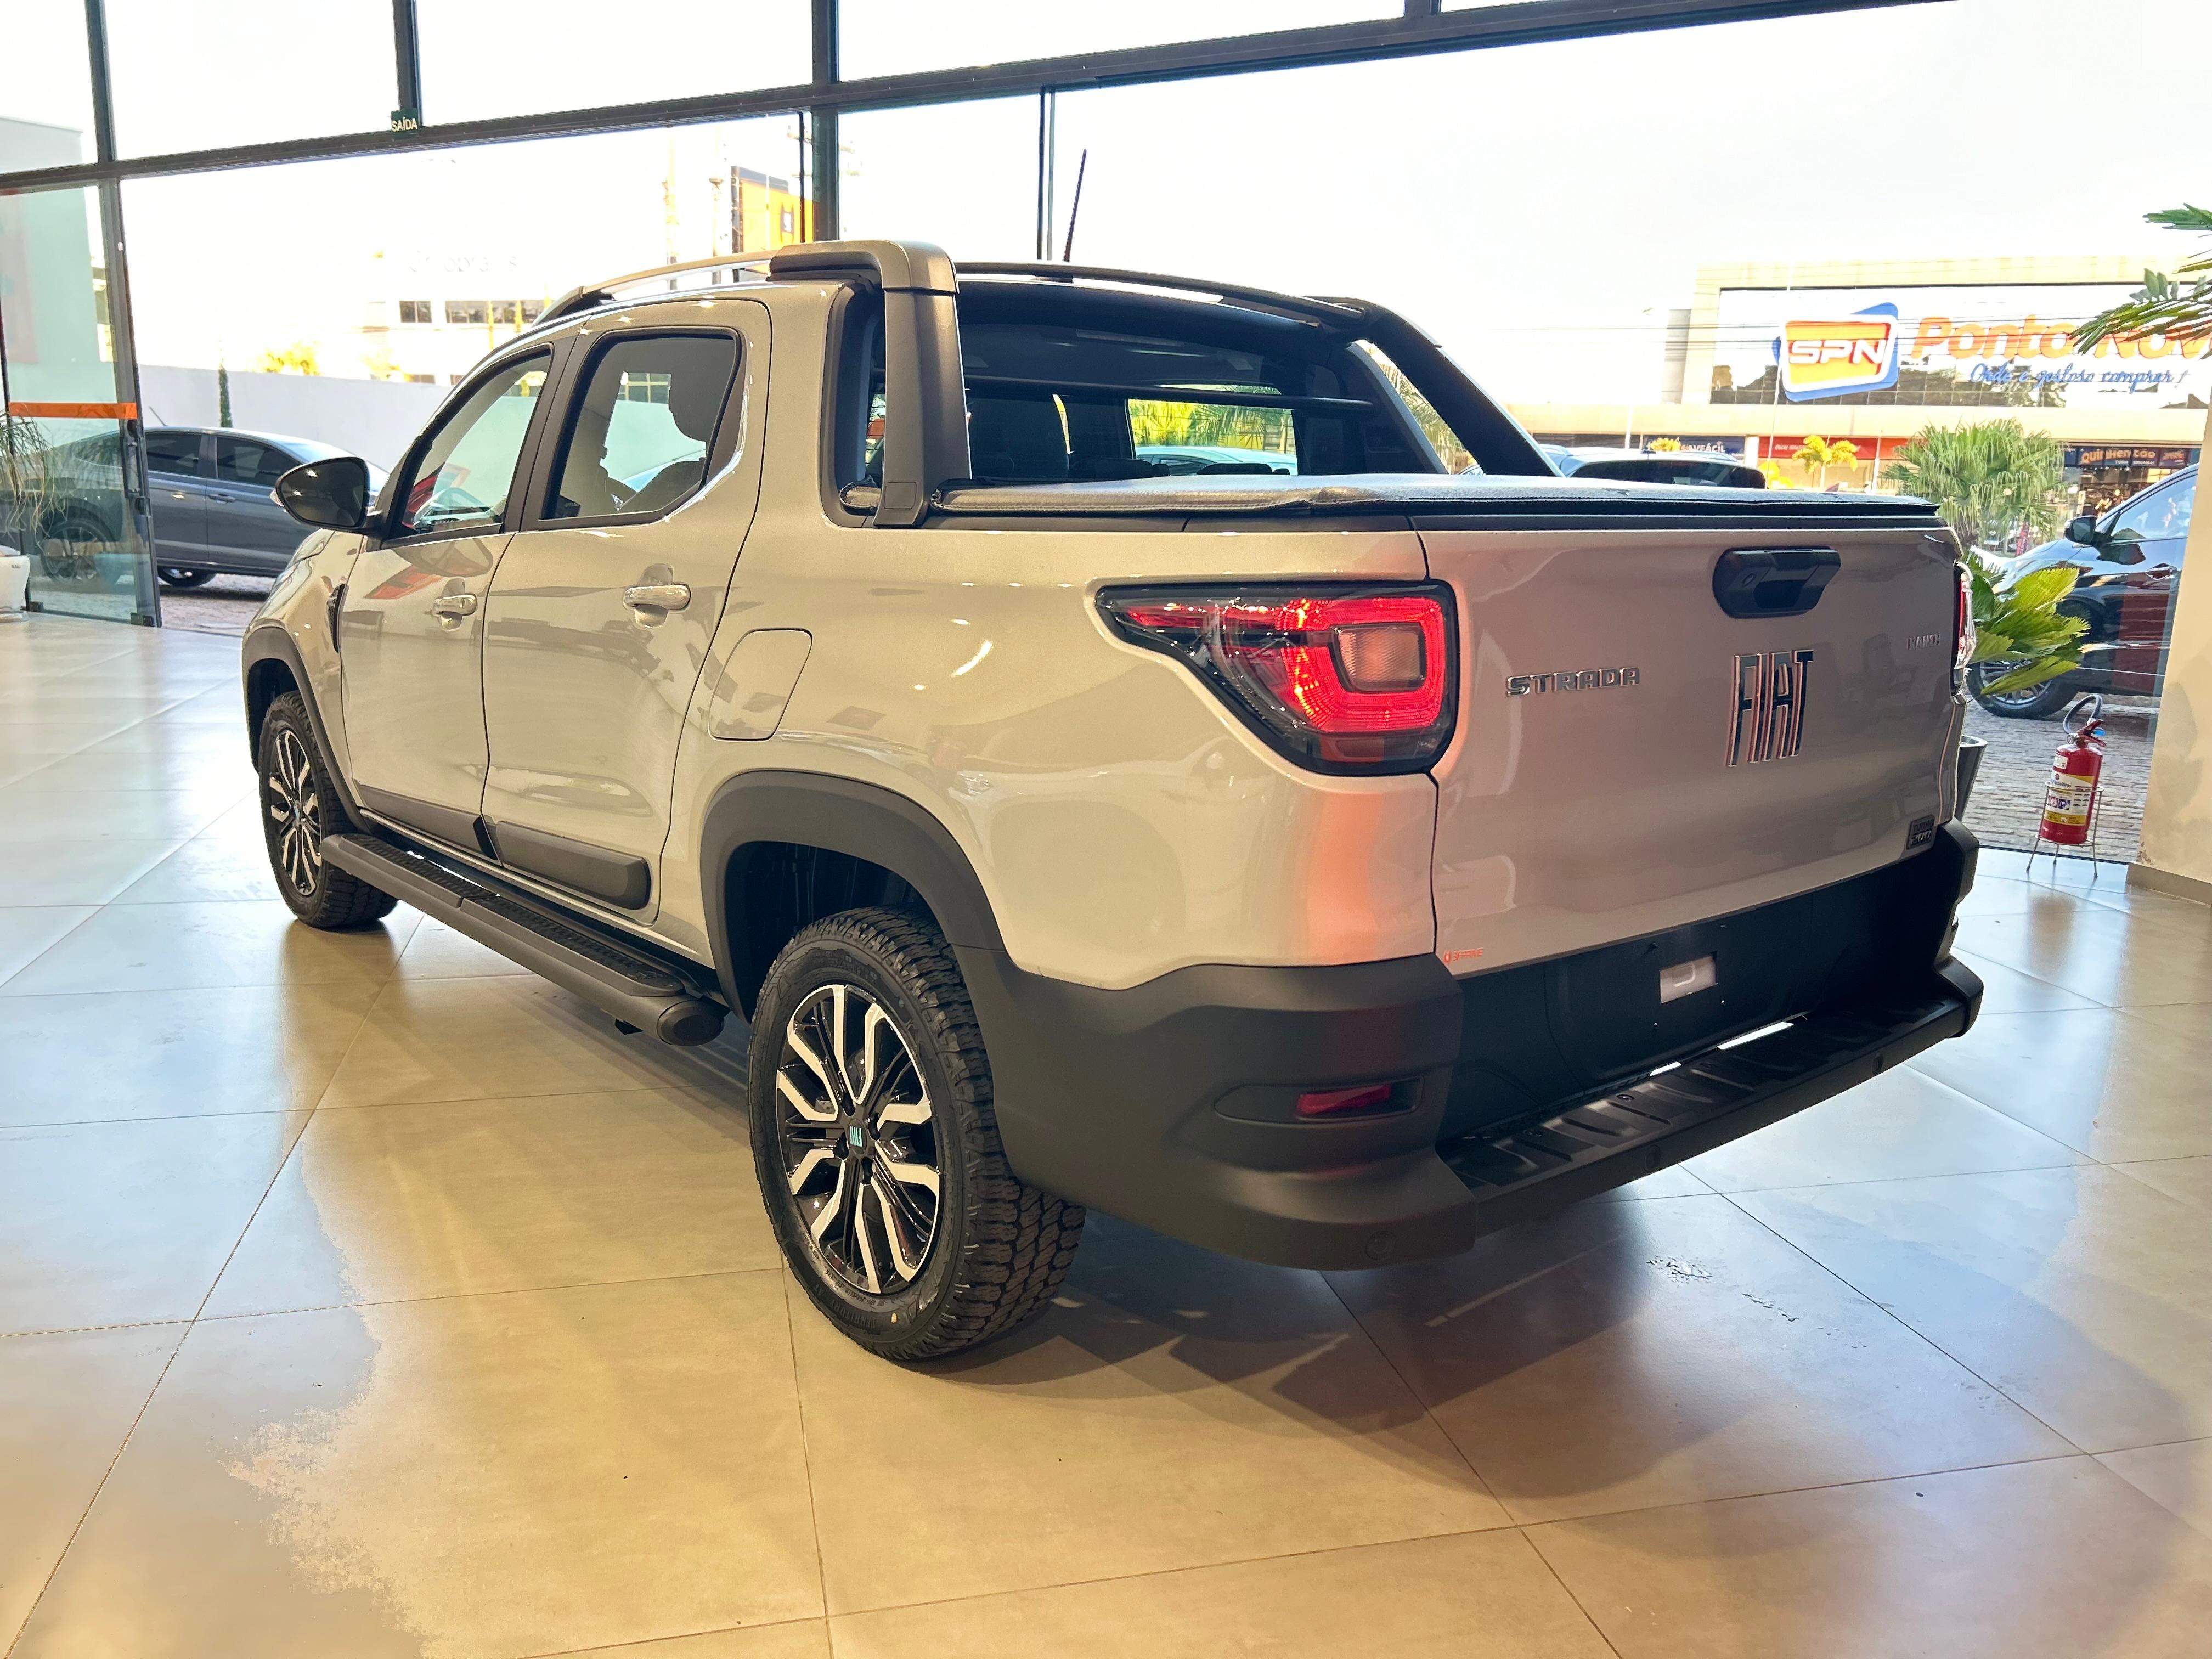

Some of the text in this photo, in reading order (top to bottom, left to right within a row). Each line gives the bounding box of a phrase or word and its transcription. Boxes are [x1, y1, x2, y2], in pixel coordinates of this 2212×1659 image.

[391, 116, 418, 132] SAÍDA
[1911, 314, 2212, 359] Ponto Nov
[1789, 339, 1886, 364] SPN
[2033, 362, 2095, 389] gostoso
[1506, 667, 1640, 697] STRADA
[1725, 650, 1814, 768] FIAT
[849, 1126, 863, 1147] FIAT
